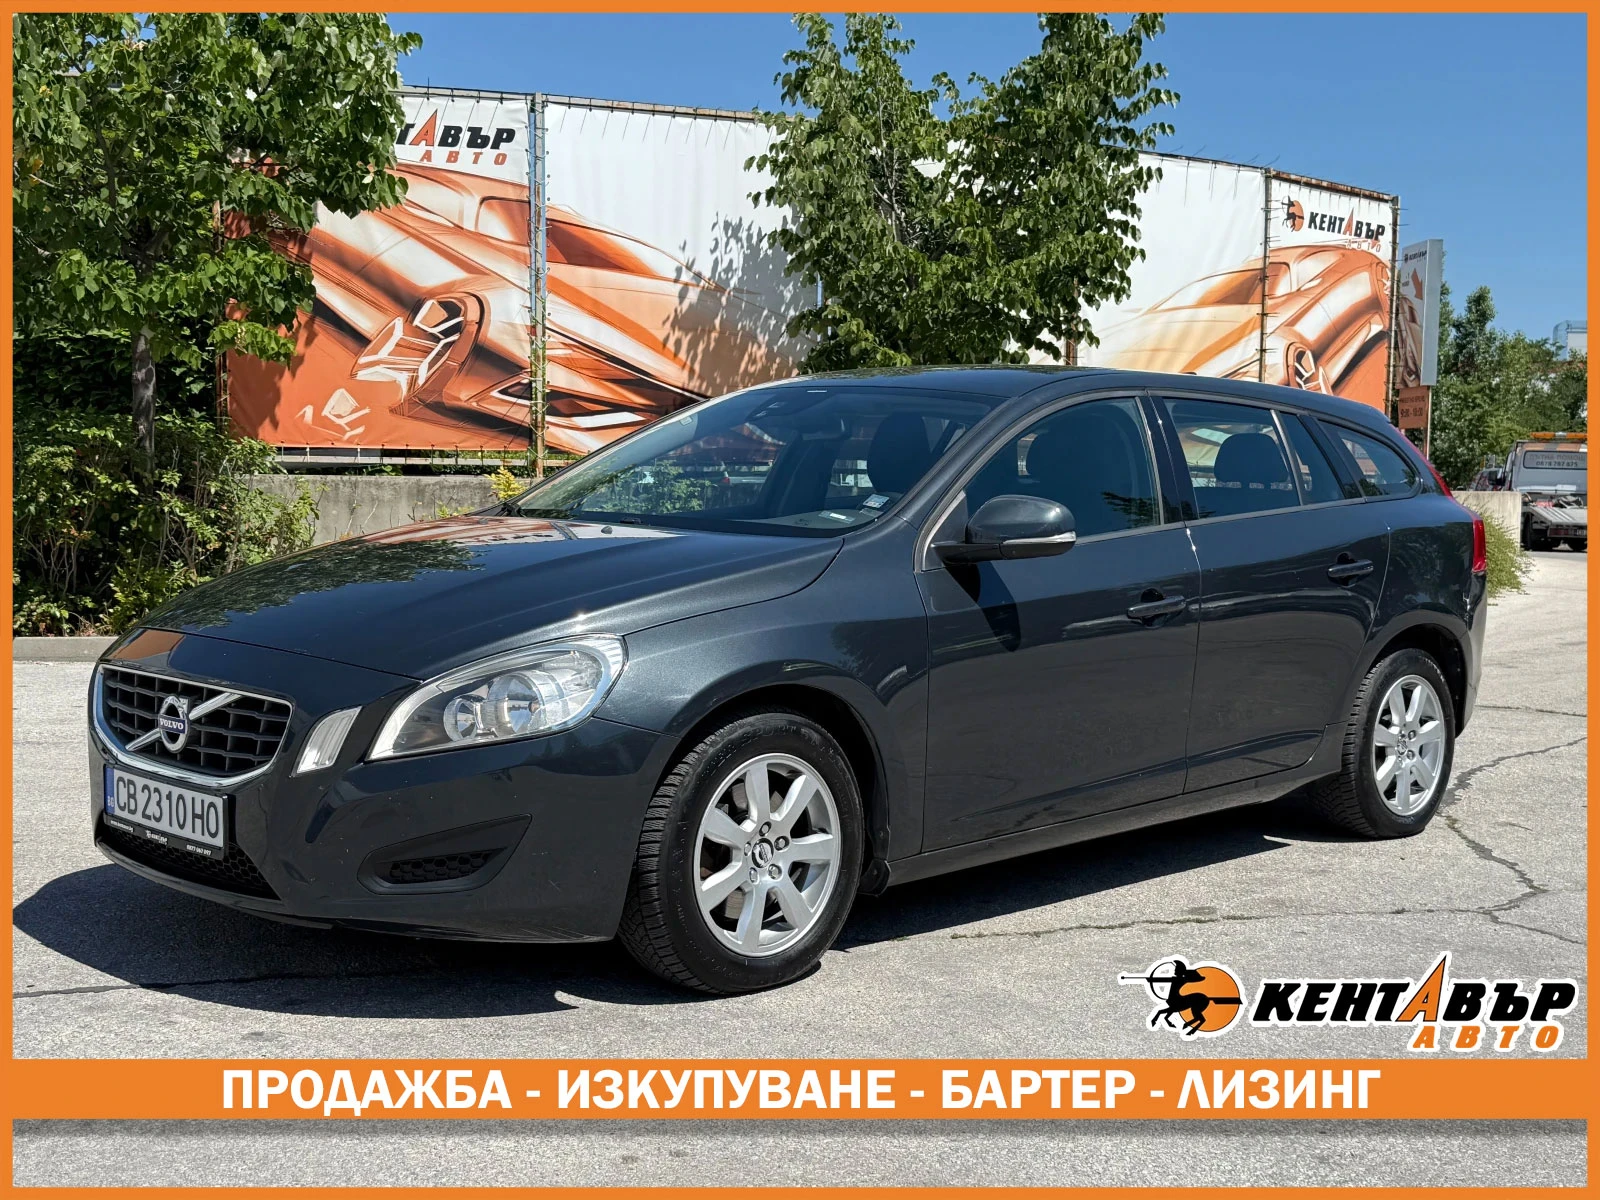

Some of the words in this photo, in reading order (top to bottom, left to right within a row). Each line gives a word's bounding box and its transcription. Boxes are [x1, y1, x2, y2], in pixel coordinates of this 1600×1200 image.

[420, 149, 508, 166] АВТО
[1307, 207, 1386, 241] КЕНТАВЪР
[159, 717, 184, 730] VOLVO
[107, 796, 115, 808] BG
[141, 783, 187, 830] 2310
